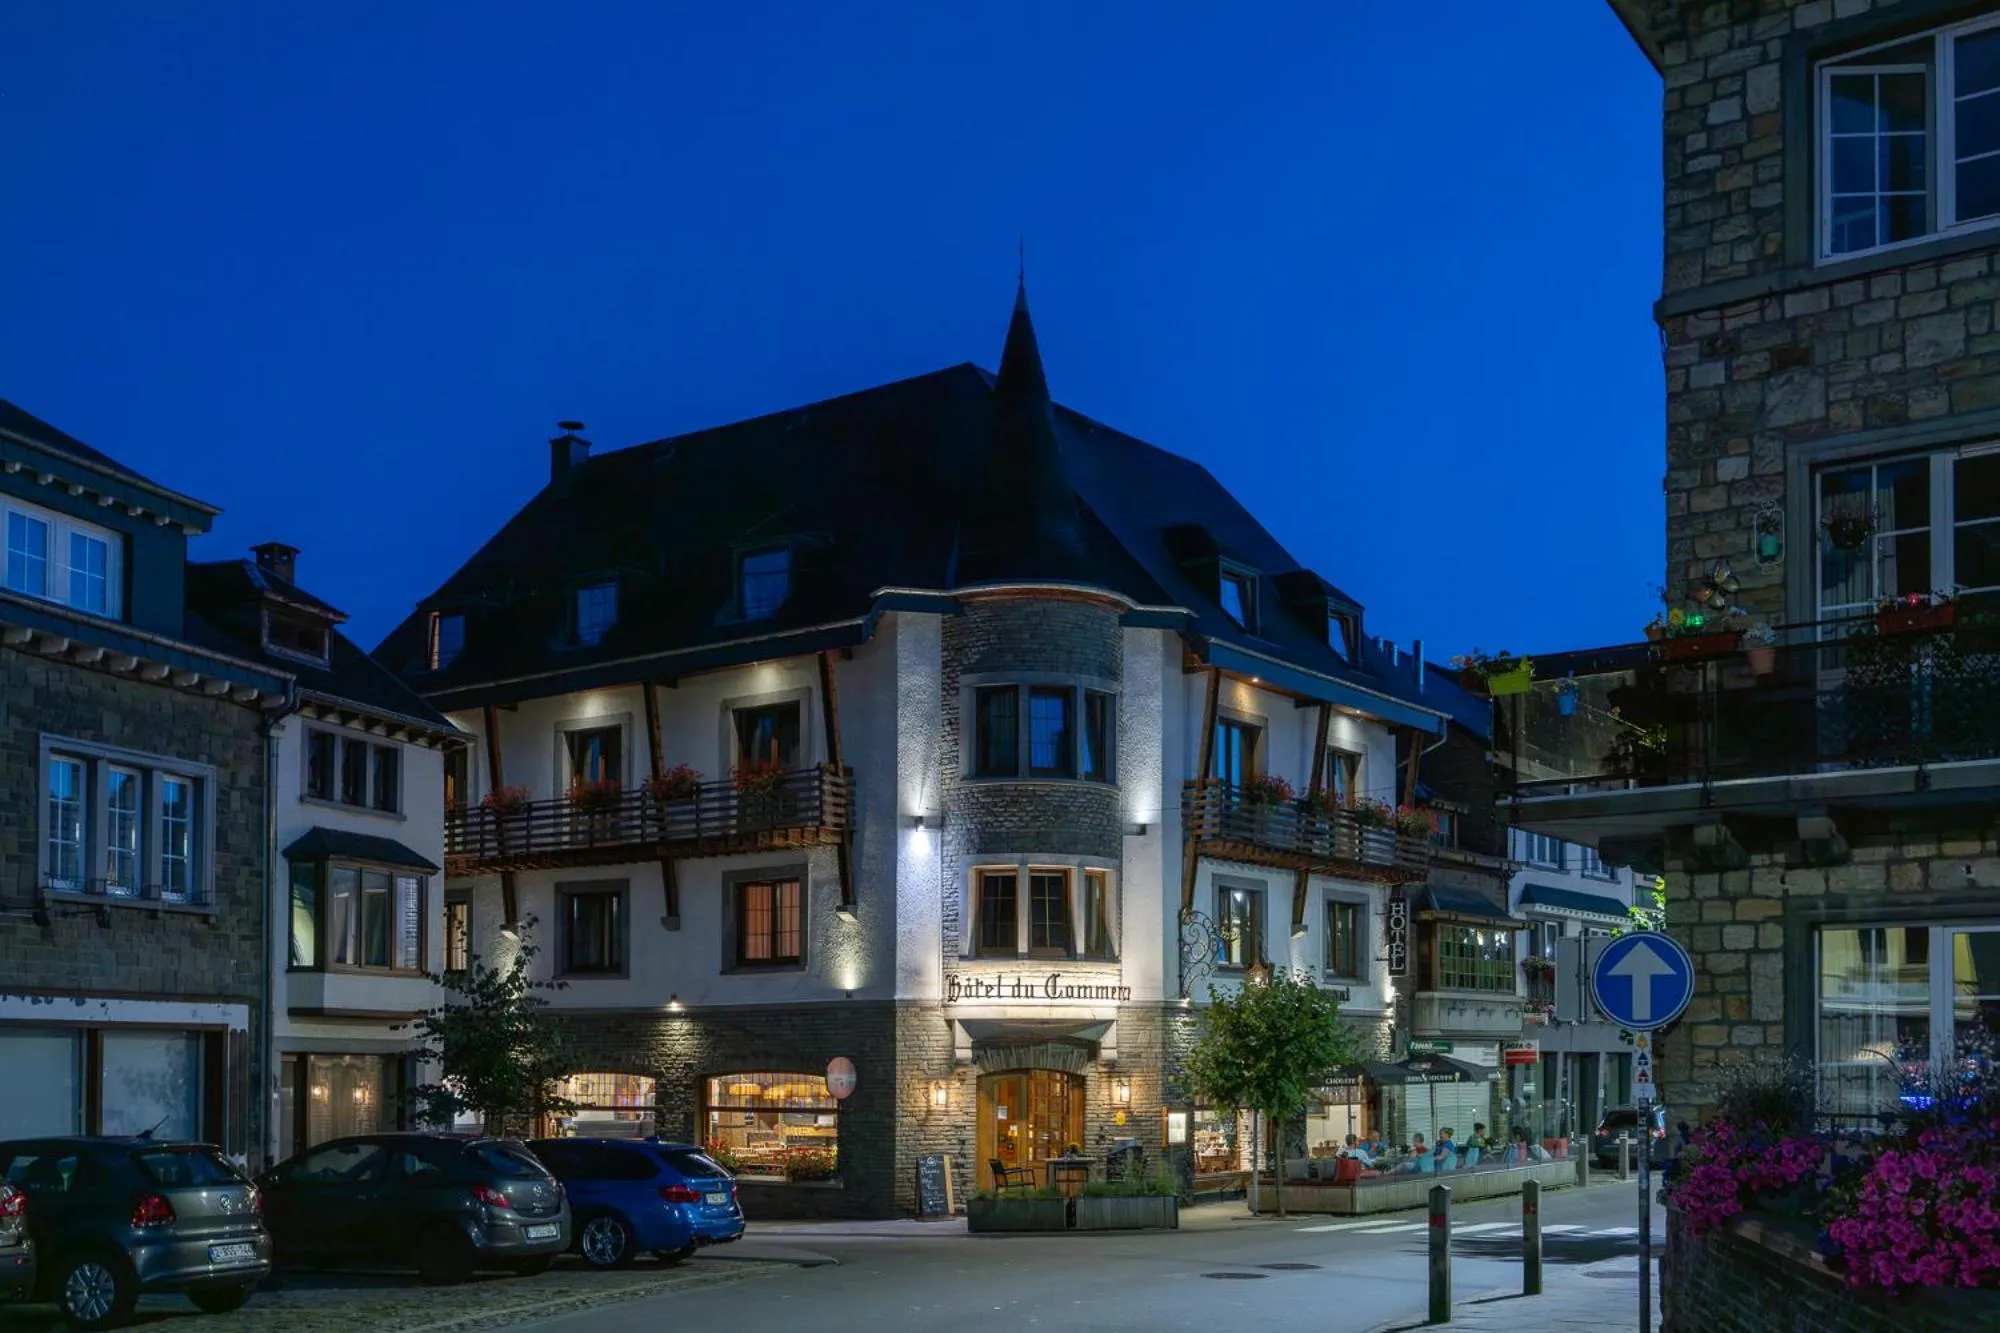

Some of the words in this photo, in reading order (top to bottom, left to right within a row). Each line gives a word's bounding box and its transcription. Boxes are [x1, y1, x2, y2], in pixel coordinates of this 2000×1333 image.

[1390, 903, 1405, 970] HOTEL
[946, 973, 1002, 1002] Hôtel
[1011, 976, 1035, 999] du
